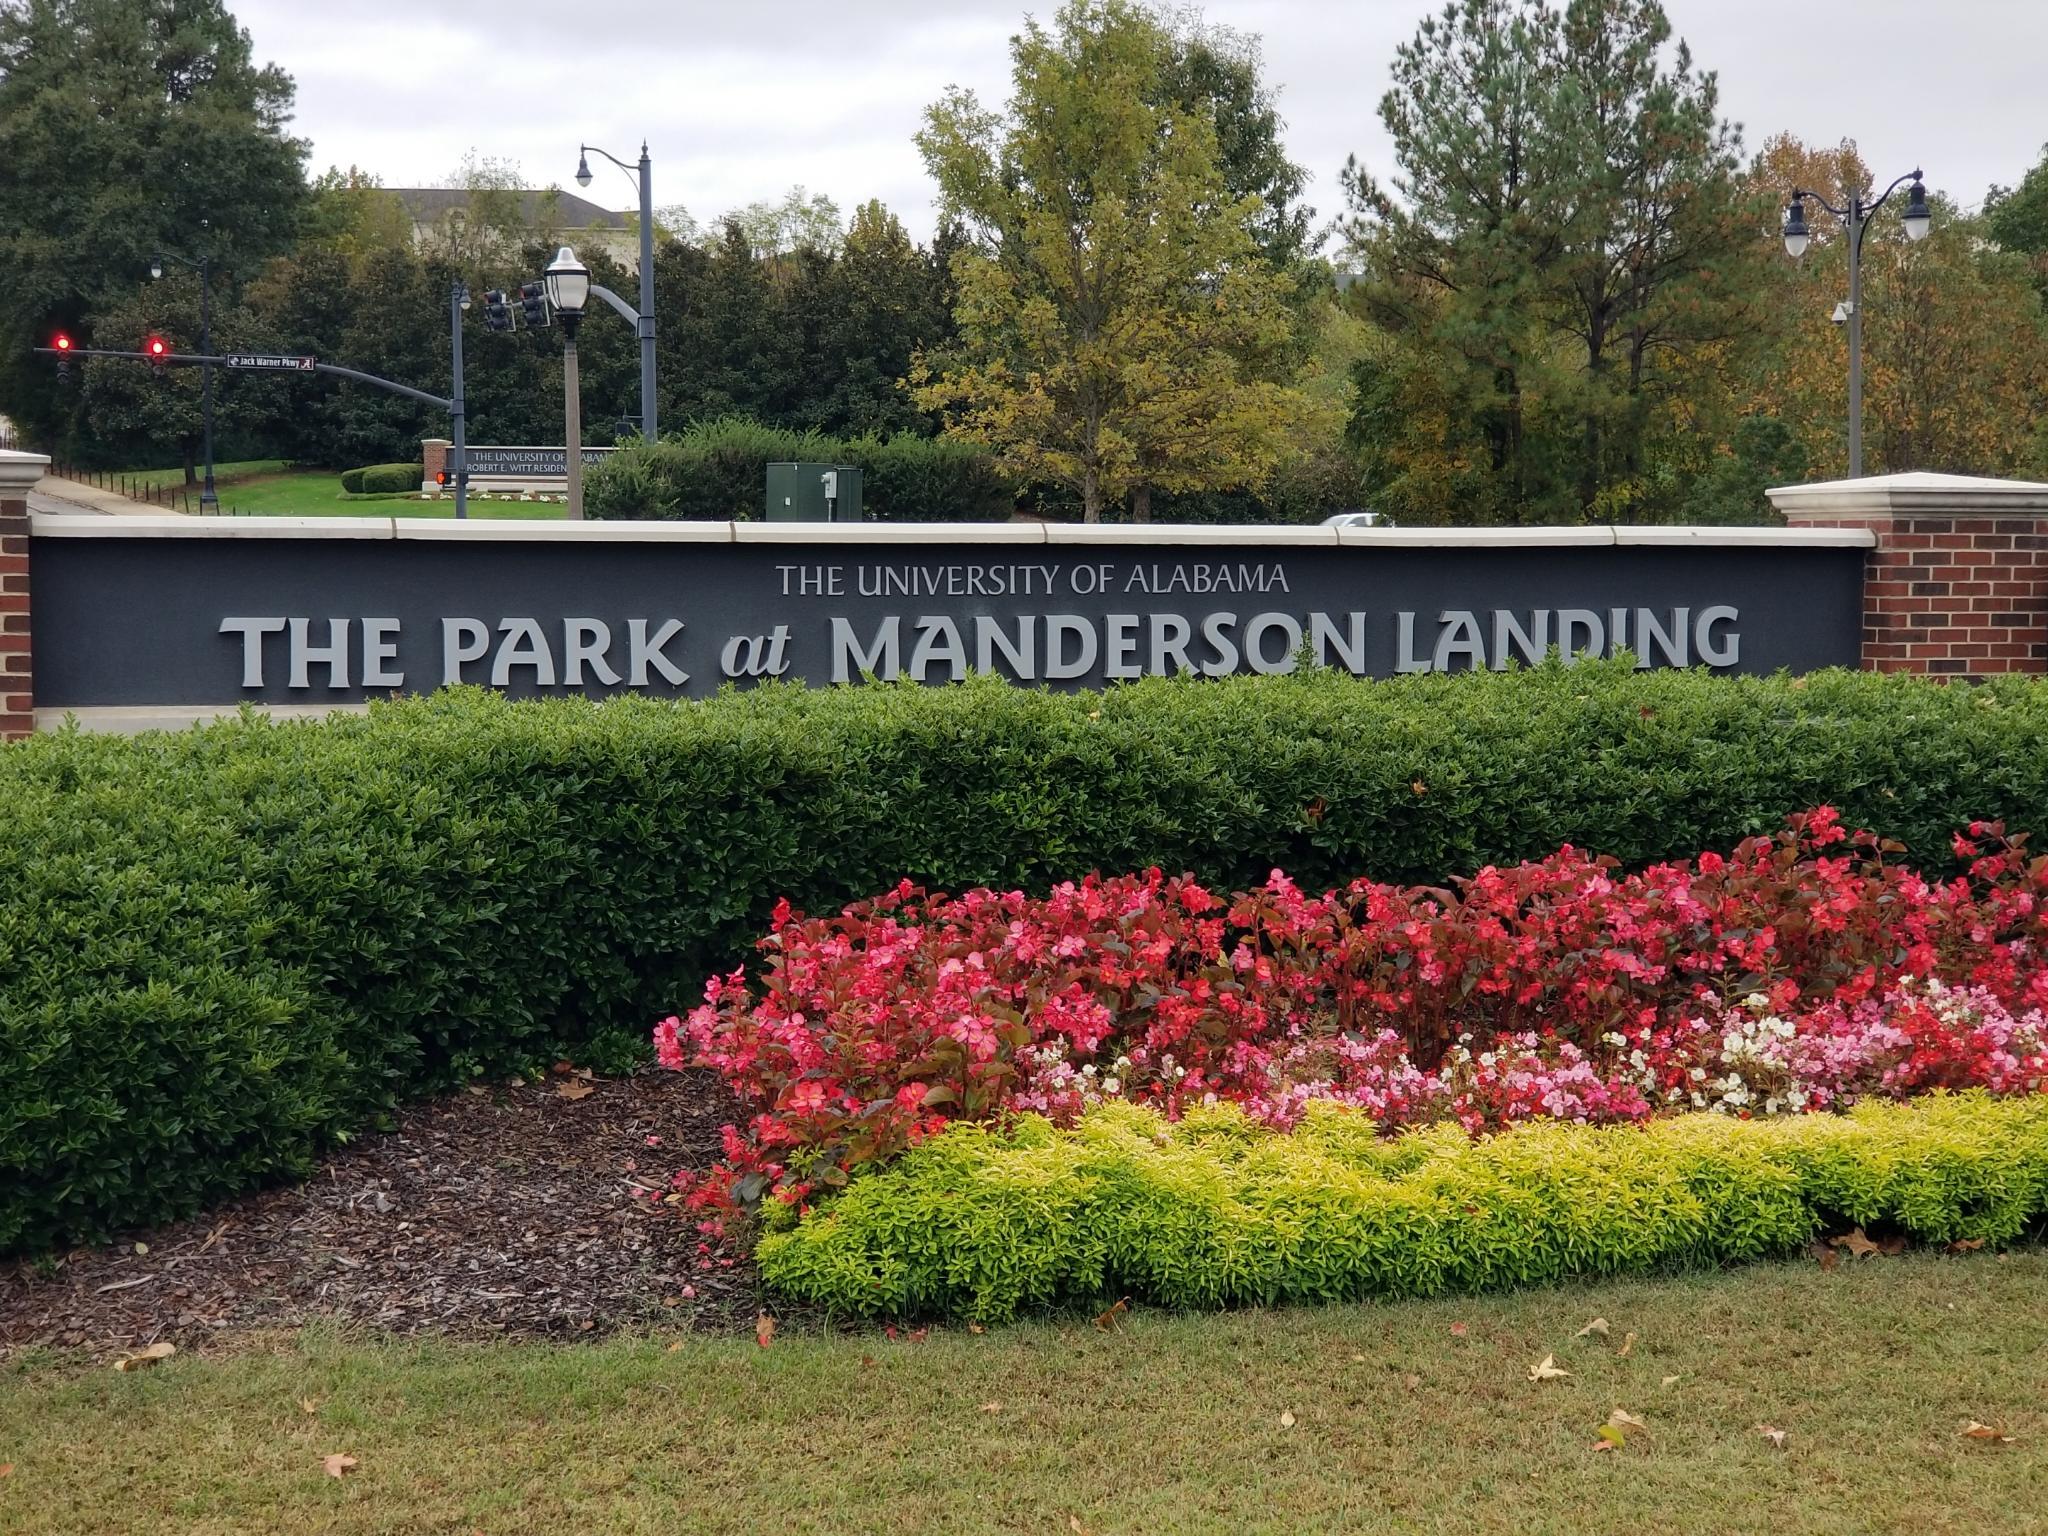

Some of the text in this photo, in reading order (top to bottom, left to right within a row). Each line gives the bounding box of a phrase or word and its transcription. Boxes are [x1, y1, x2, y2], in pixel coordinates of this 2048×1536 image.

[240, 357, 255, 366] Jack
[256, 357, 280, 367] Warner
[282, 358, 299, 369] Pkwy
[474, 452, 493, 462] THE
[495, 452, 551, 462] UNIVERSITY
[552, 452, 566, 462] OF
[467, 463, 498, 473] ROBERT
[500, 464, 507, 473] E.
[510, 464, 532, 473] WITT
[775, 563, 1291, 597] THE UNIVERSITY OF ALABAMA
[218, 605, 1741, 689] THE PARK at MANDERSON LANDING
